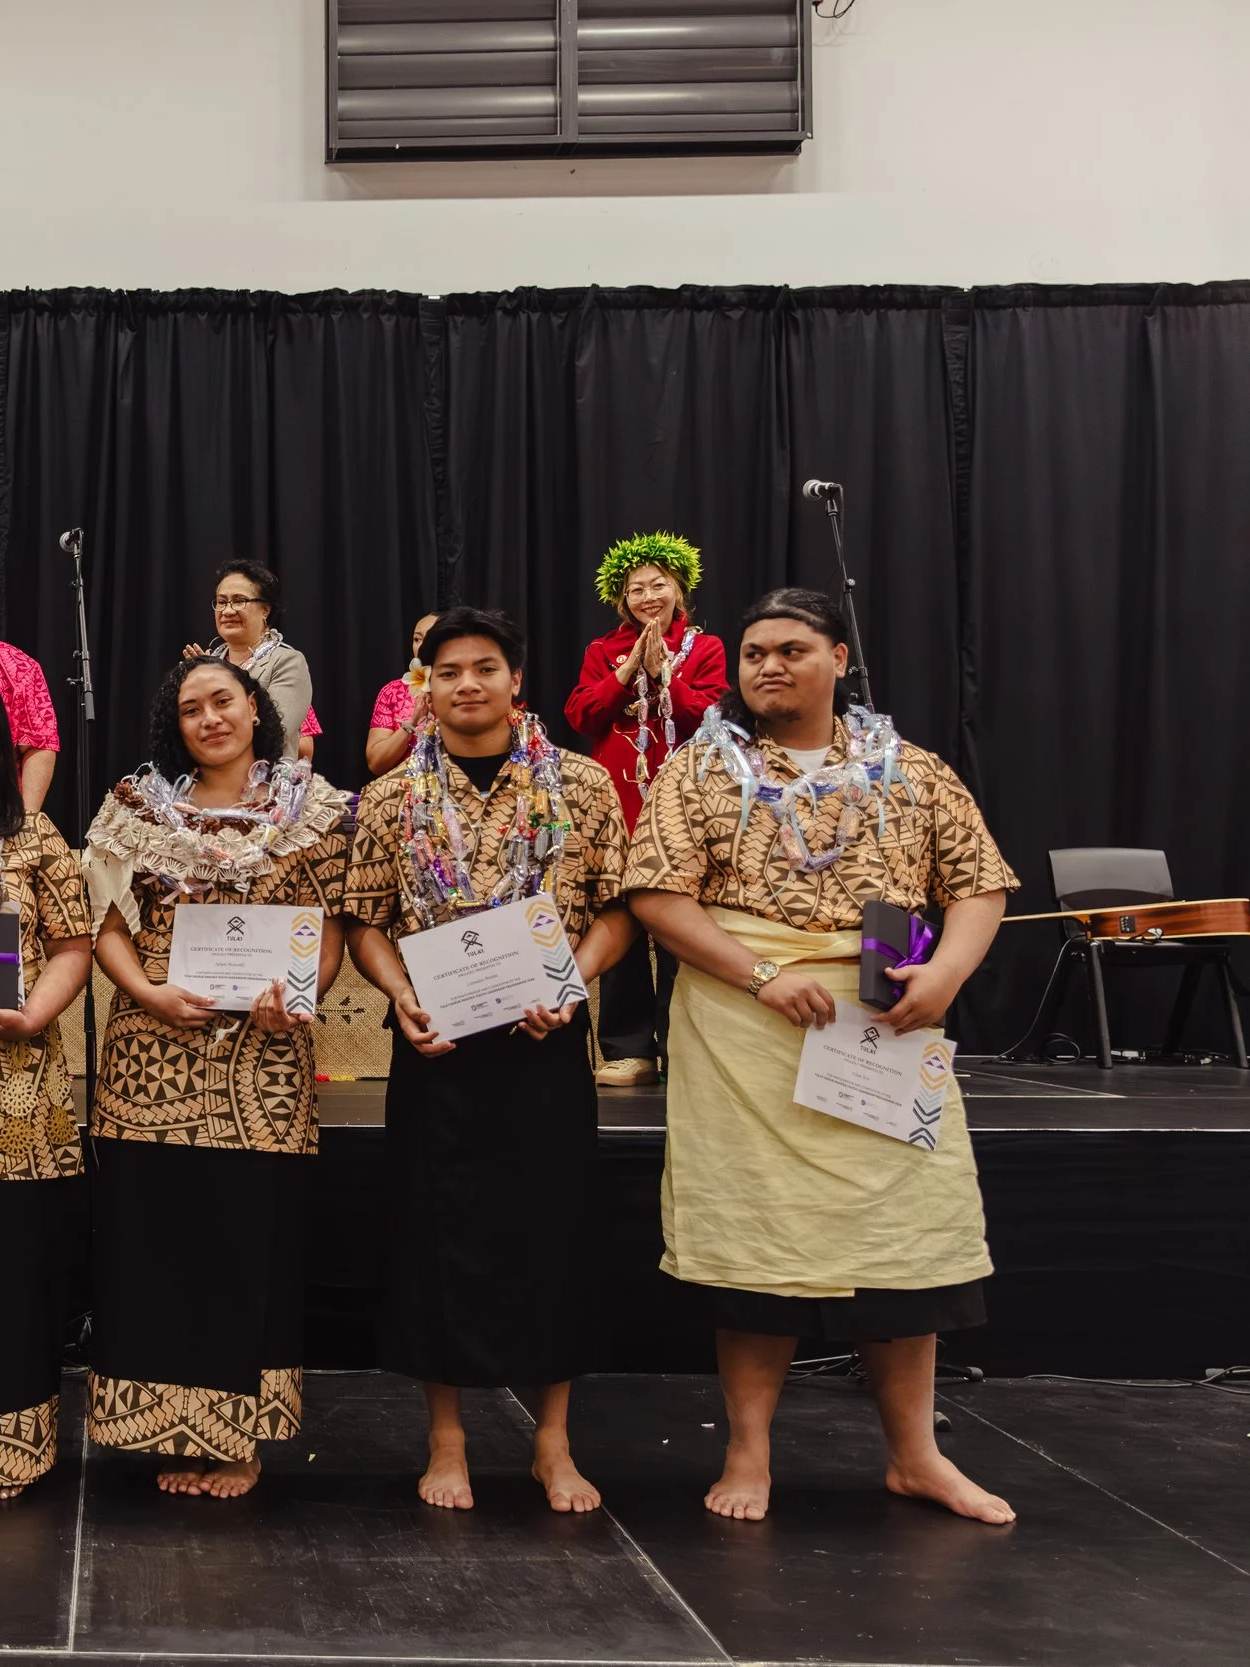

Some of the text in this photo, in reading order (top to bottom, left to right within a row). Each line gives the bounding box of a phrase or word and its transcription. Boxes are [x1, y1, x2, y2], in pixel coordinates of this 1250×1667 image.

[433, 966, 470, 980] CERTIFICATE
[479, 950, 519, 966] RECOGNITION
[823, 1045, 856, 1060] CERTIFICATE
[866, 1060, 902, 1076] RECOGNITION
